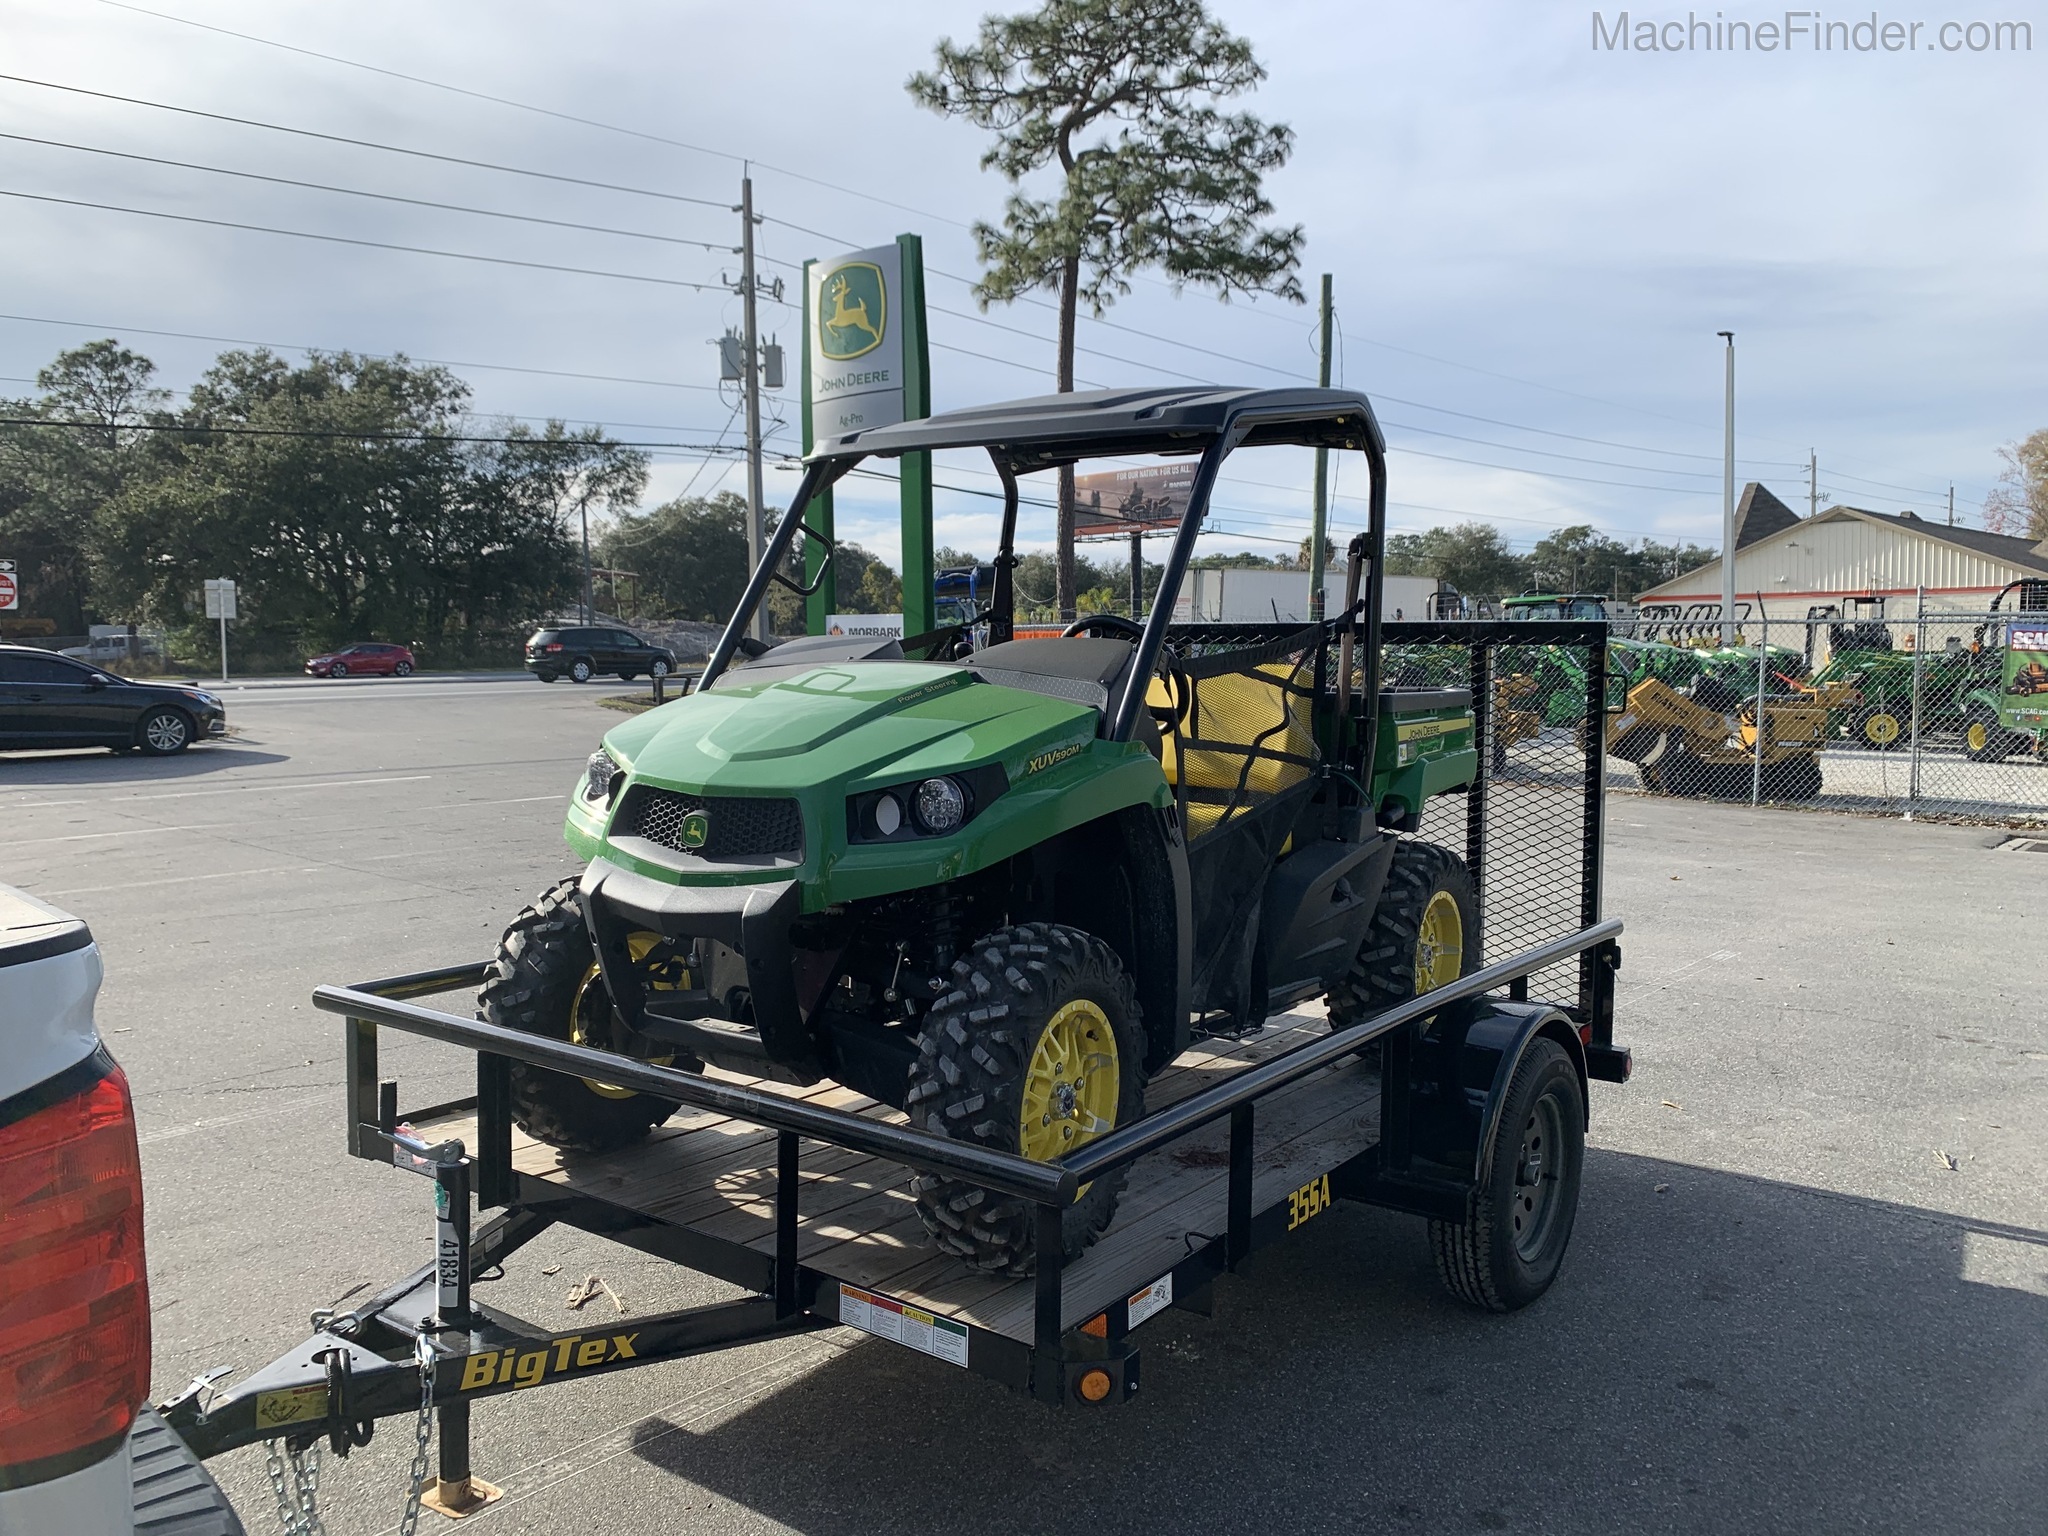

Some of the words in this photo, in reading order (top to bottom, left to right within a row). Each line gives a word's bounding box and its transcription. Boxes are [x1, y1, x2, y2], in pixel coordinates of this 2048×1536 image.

[818, 376, 846, 393] JOHN
[847, 370, 889, 387] DEERE
[839, 413, 863, 427] Ag-Pro
[1116, 472, 1127, 481] FOR
[1128, 470, 1139, 479] OUR
[1160, 466, 1171, 476] FOR
[1172, 465, 1180, 474] US
[897, 690, 922, 704] Power
[924, 678, 958, 693] Steering
[1408, 727, 1423, 740] JOHN
[1423, 724, 1440, 737] DEERE
[440, 1239, 459, 1289] 41834
